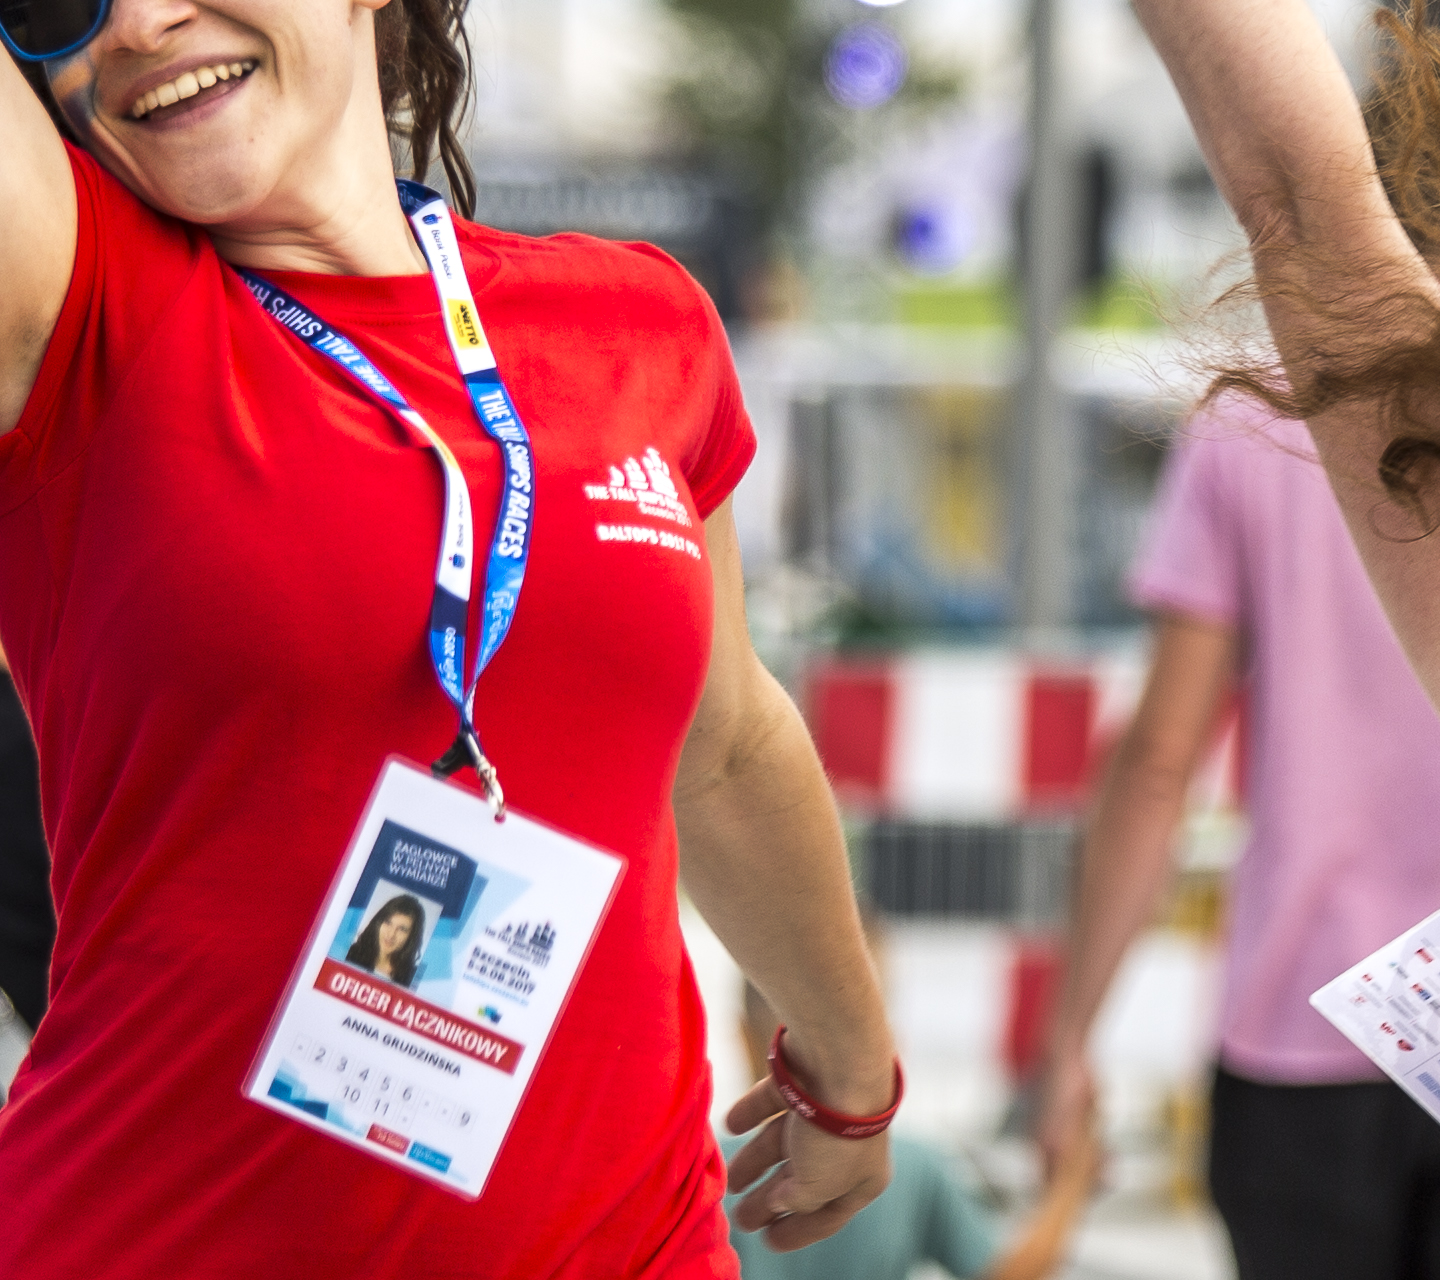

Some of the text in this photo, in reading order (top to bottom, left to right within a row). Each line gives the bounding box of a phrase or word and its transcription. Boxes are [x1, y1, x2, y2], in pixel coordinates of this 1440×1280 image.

[266, 296, 391, 392] THE TALL SHIPS
[479, 389, 511, 422] THE
[498, 489, 531, 559] RACES
[584, 485, 610, 500] THE
[609, 486, 637, 501] TALL
[596, 524, 658, 545] BALTOPS
[658, 530, 685, 551] 2017
[330, 972, 509, 1064] OFICER ŁĄCZNIKOWY
[341, 1016, 462, 1078] ANNA GRUDZIŃSKA
[341, 1083, 362, 1104] 10
